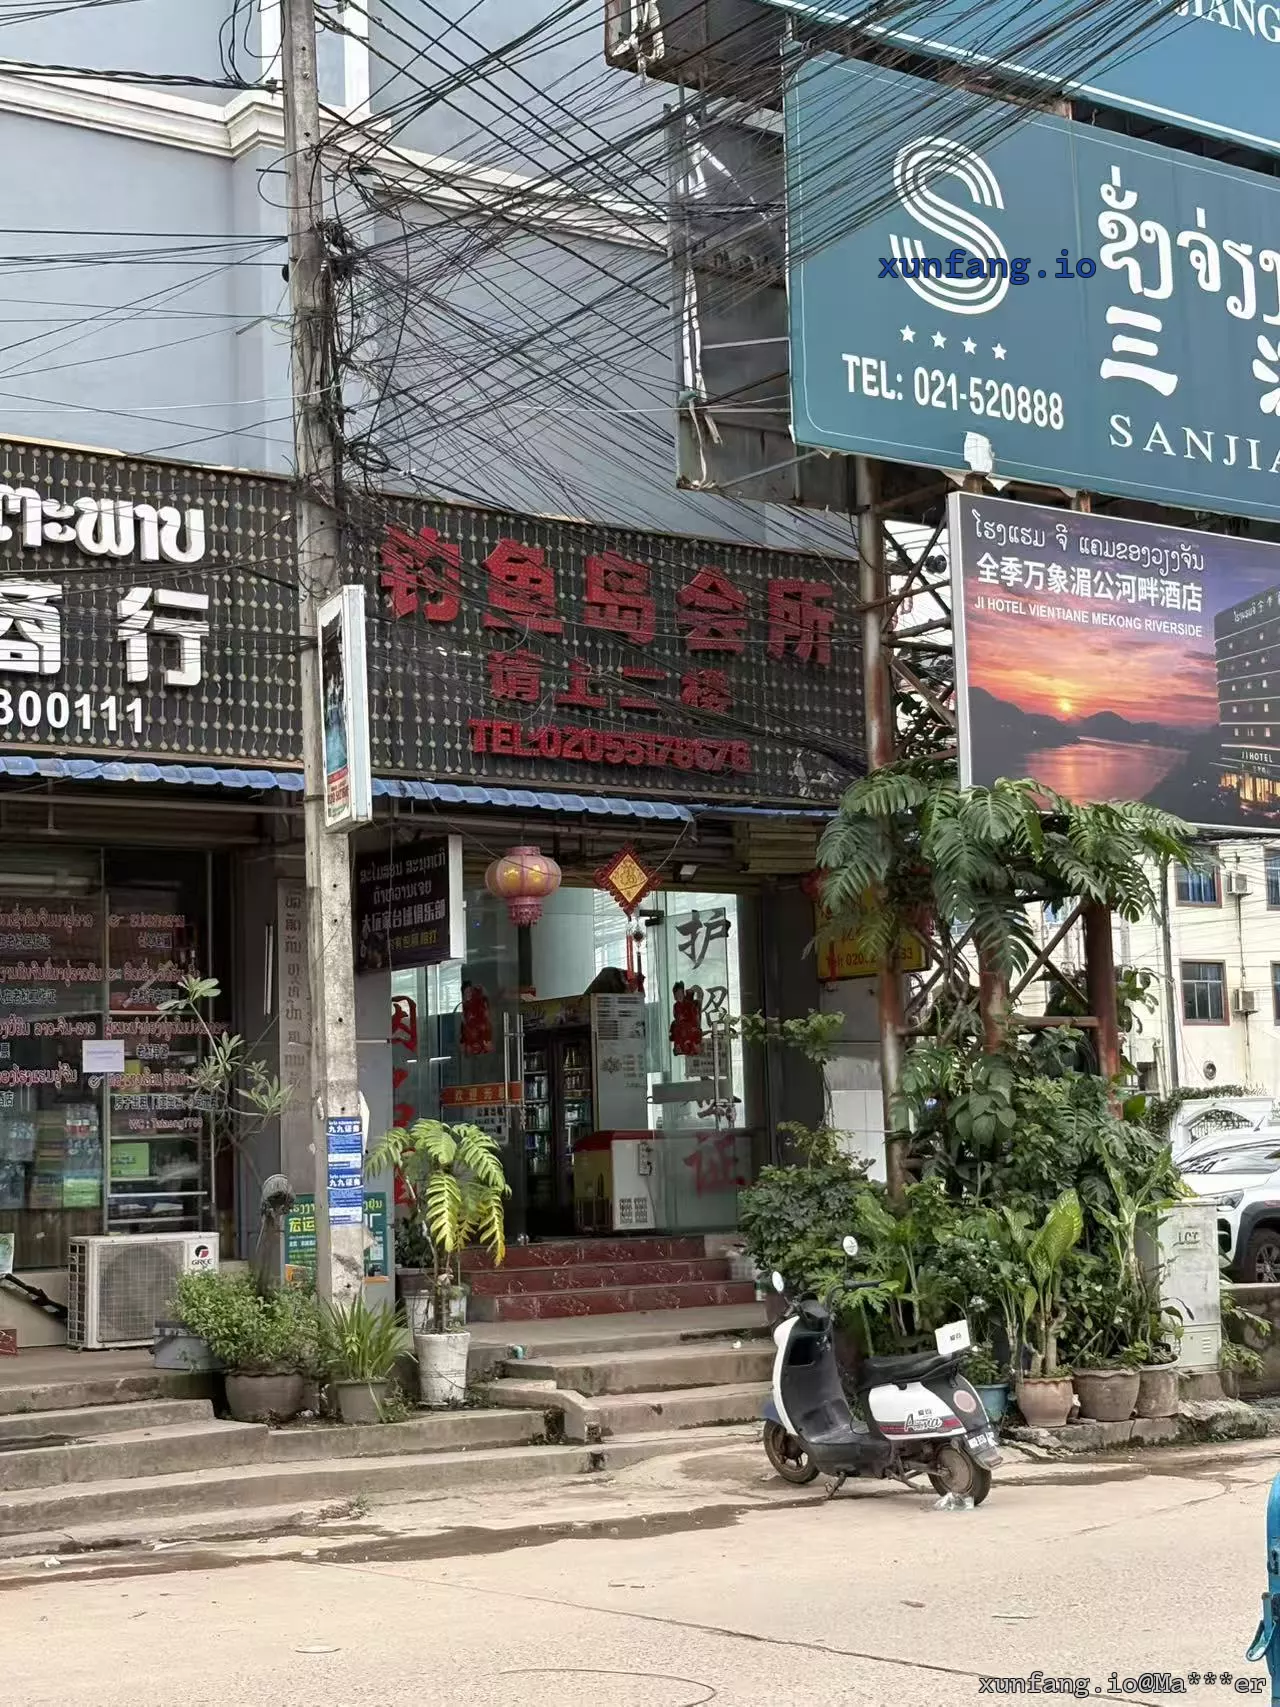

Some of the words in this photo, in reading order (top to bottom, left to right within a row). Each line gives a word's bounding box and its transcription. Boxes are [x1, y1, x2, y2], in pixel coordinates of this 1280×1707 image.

[842, 353, 903, 401] TEL:
[914, 366, 1064, 430] 021-520888
[972, 508, 1046, 547] ໂຮງແຮມ
[1055, 523, 1069, 551] ຈີ
[976, 552, 1203, 612] 全季万象湄公河畔酒店
[974, 595, 985, 609] JI
[987, 597, 1027, 615] HOTEL
[1028, 603, 1089, 623] VIENTIANE
[1091, 611, 1142, 630] MEKONG
[1144, 618, 1203, 638] RIVERSIDE
[1249, 752, 1273, 763] HOTEL
